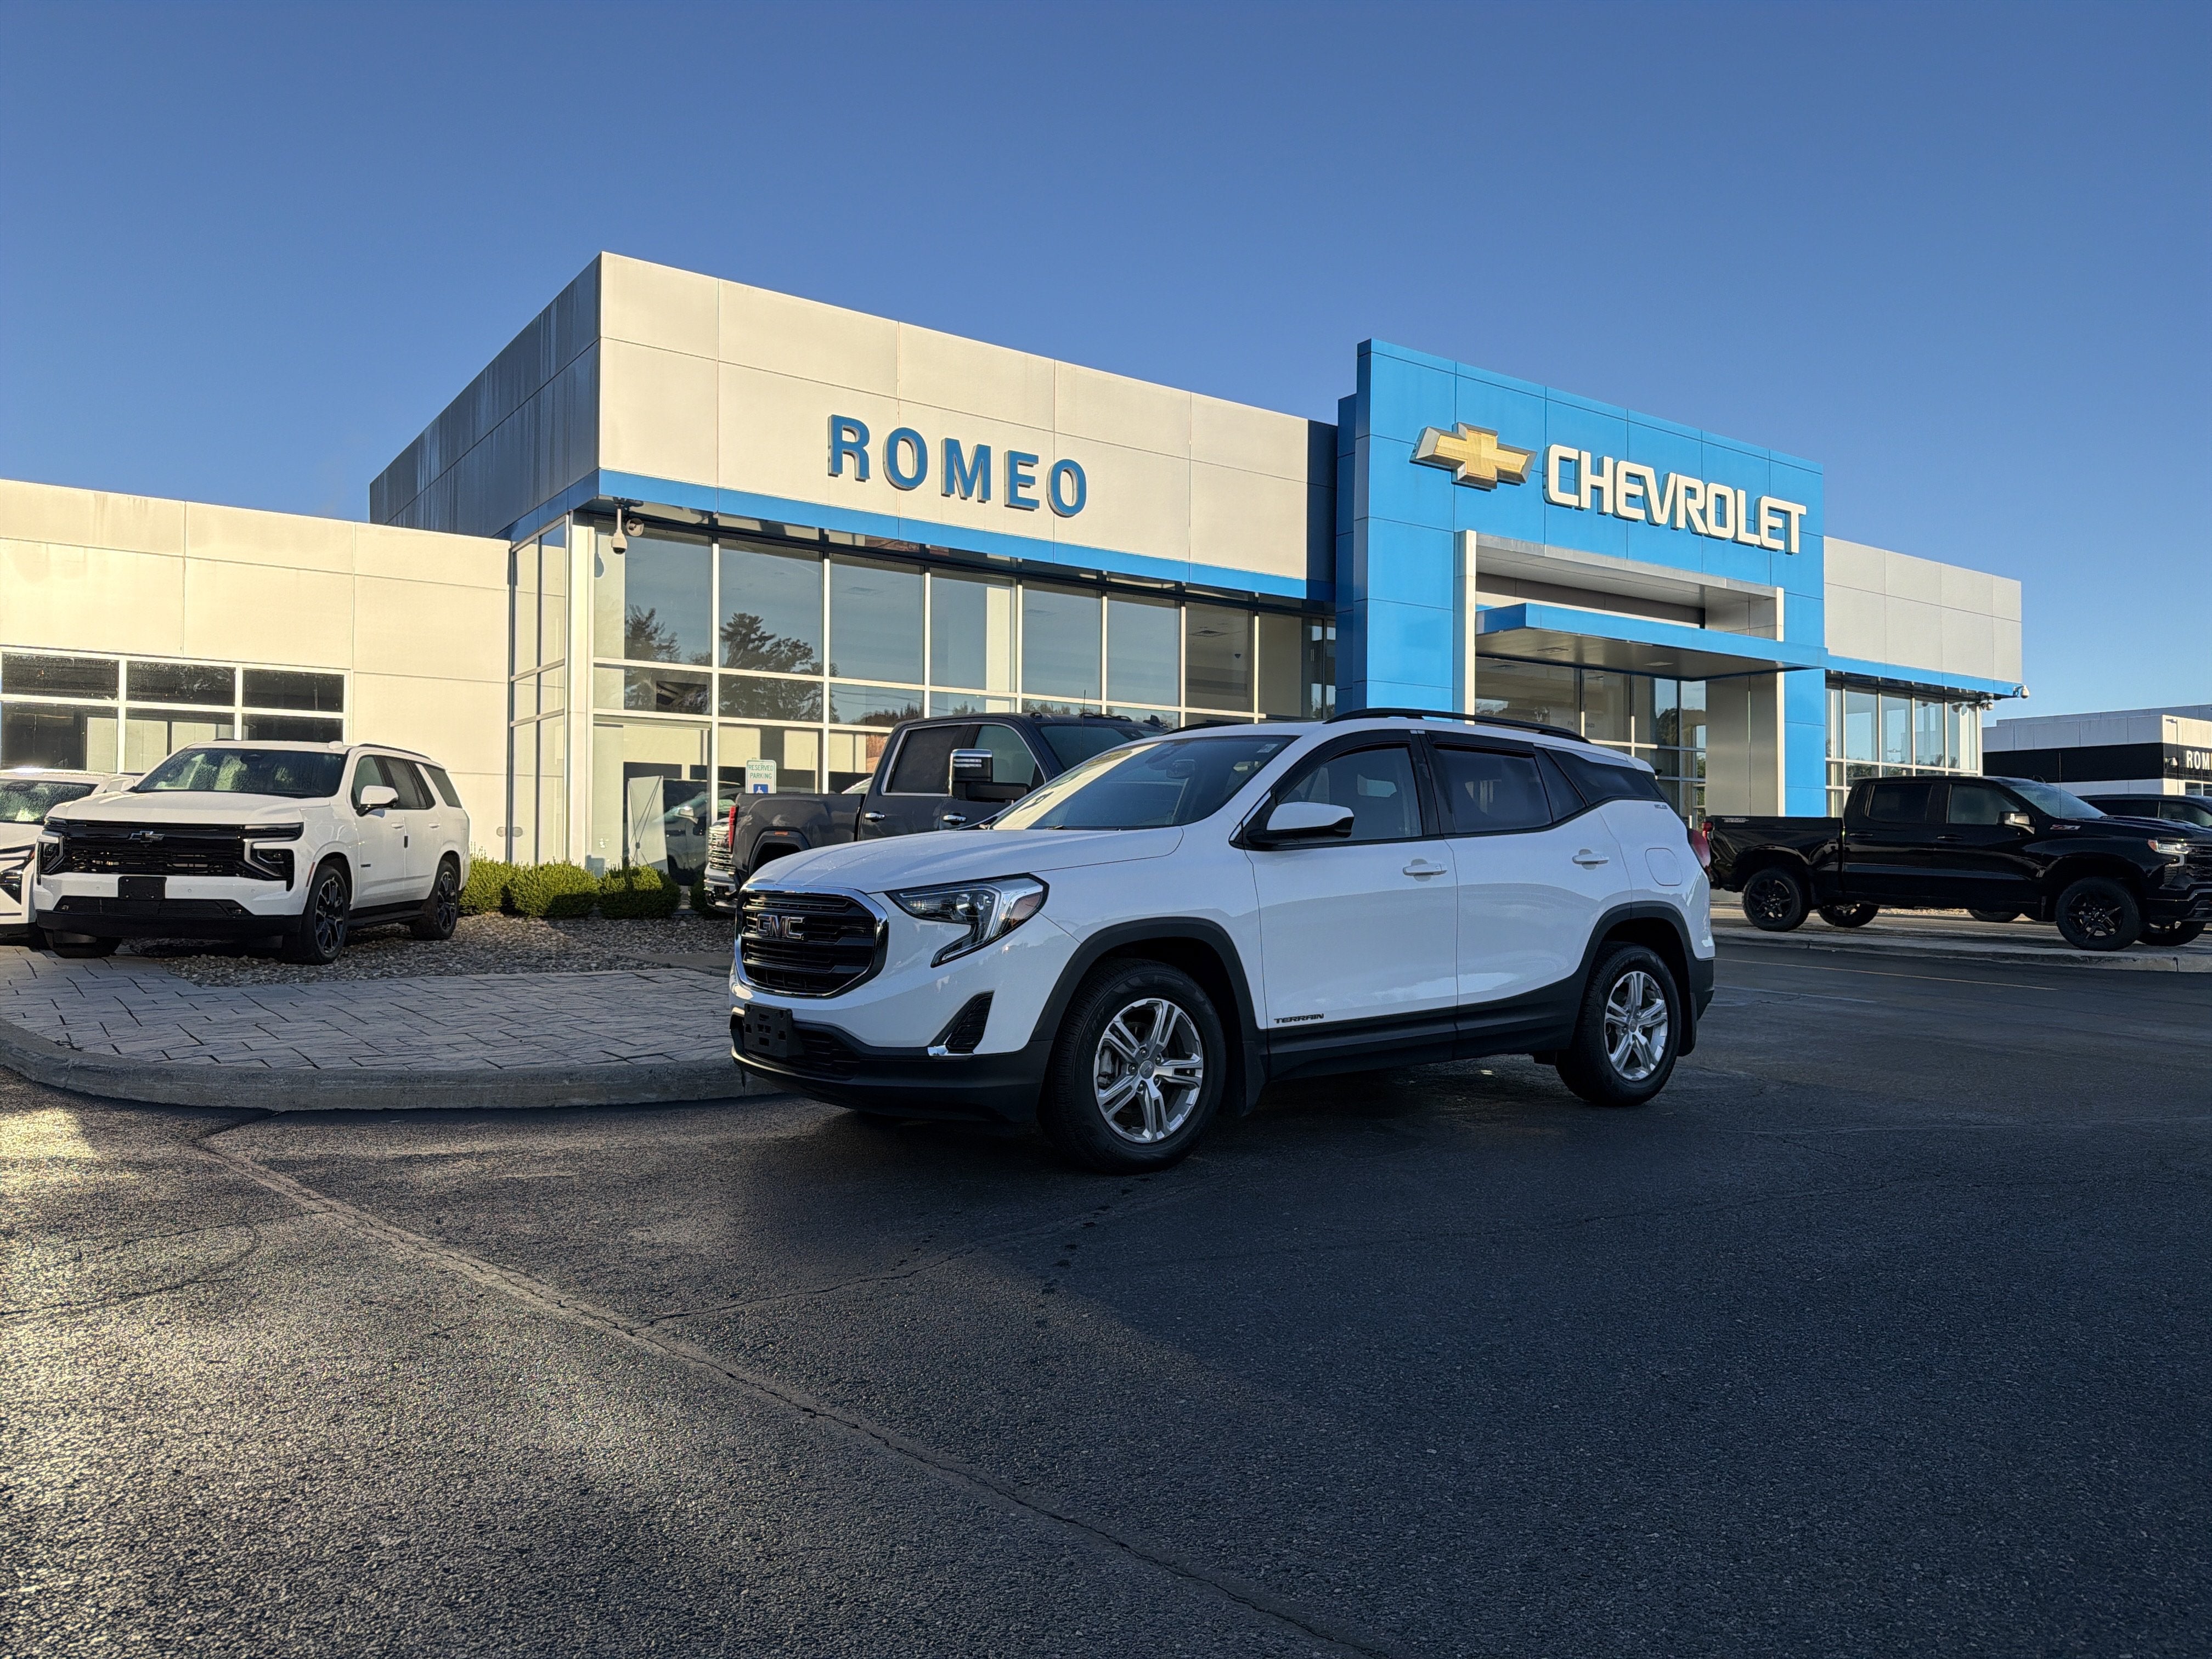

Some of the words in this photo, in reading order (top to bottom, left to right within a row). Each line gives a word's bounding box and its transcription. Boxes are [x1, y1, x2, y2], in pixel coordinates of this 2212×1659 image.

[828, 414, 1087, 518] ROMEO
[1544, 444, 1807, 555] CHEVROLET
[2186, 750, 2212, 770] ROM
[757, 913, 804, 939] GMC
[1274, 1013, 1324, 1024] TERRAIN
